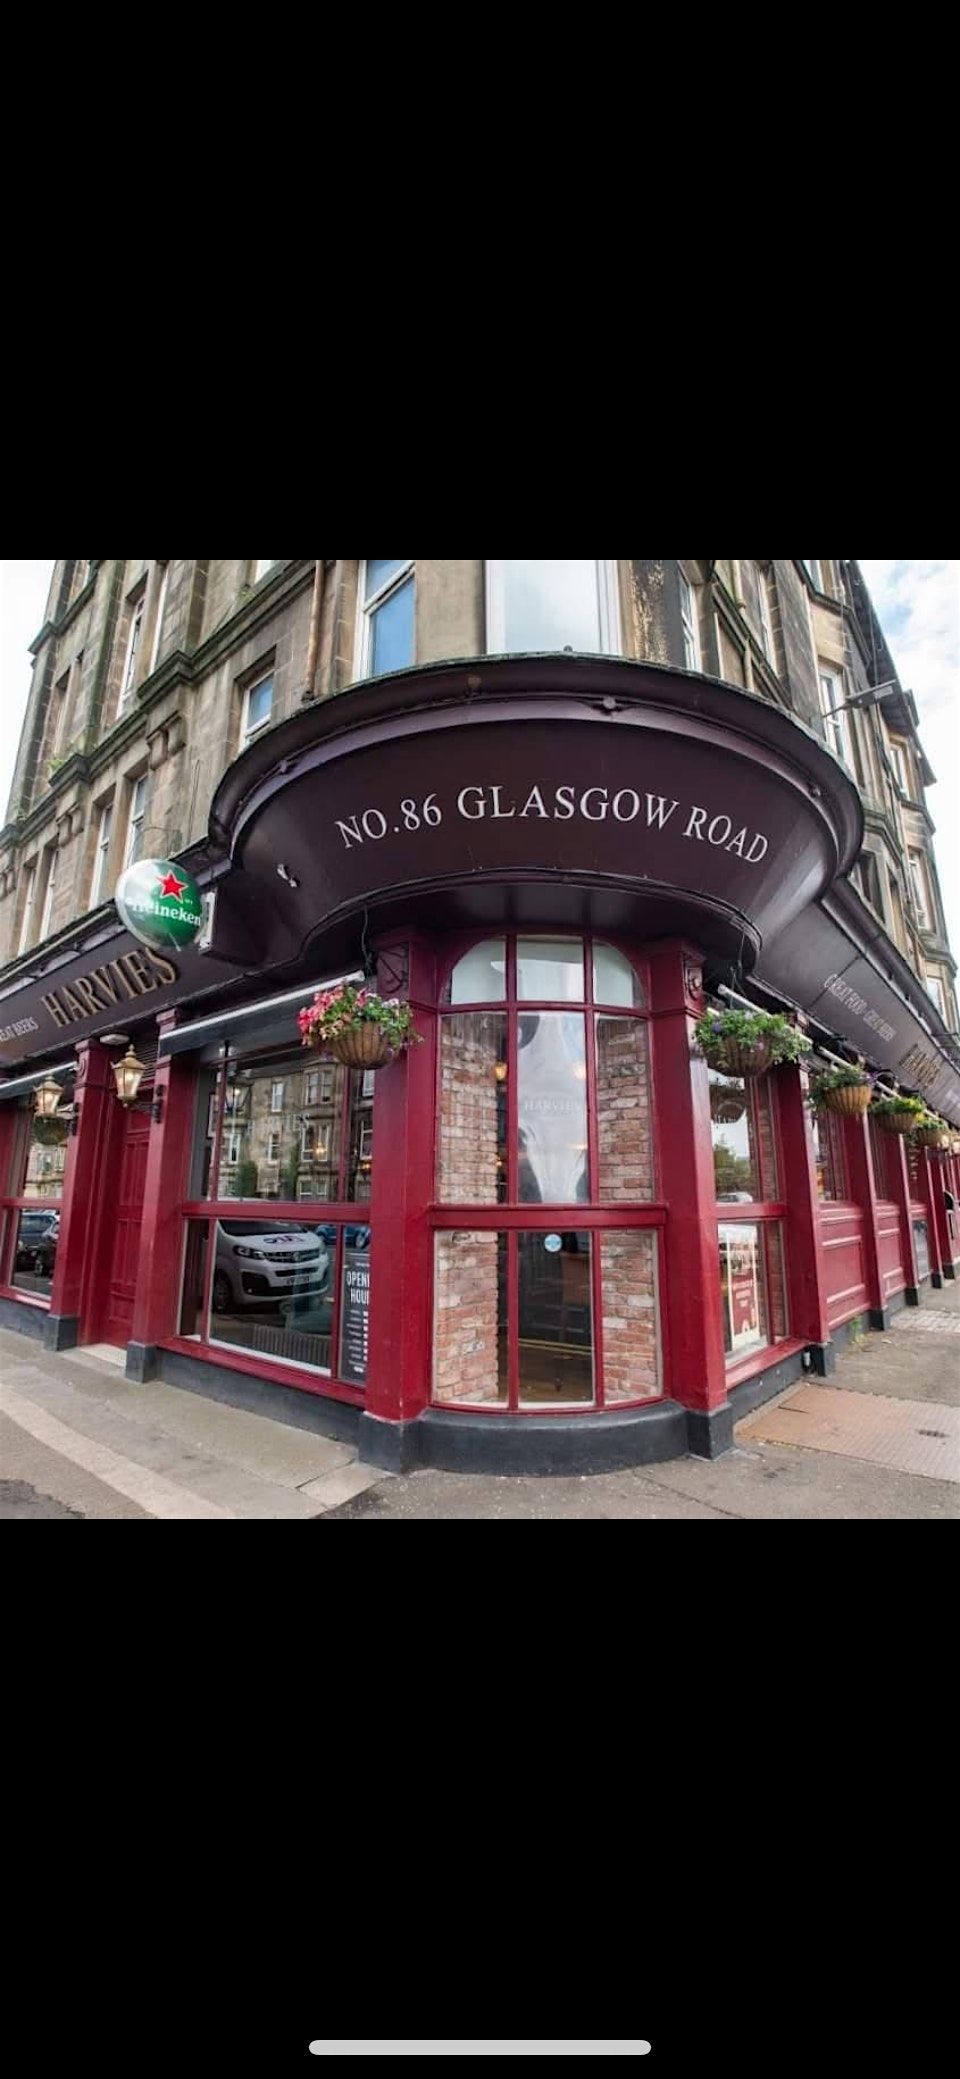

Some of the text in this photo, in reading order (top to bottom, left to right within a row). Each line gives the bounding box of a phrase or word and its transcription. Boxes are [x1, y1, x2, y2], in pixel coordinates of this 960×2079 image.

[334, 785, 769, 863] NO.86 GLASGOW ROAD
[41, 947, 178, 1028] HARVIES
[346, 1270, 370, 1288] OPENI
[350, 1287, 369, 1305] HOU
